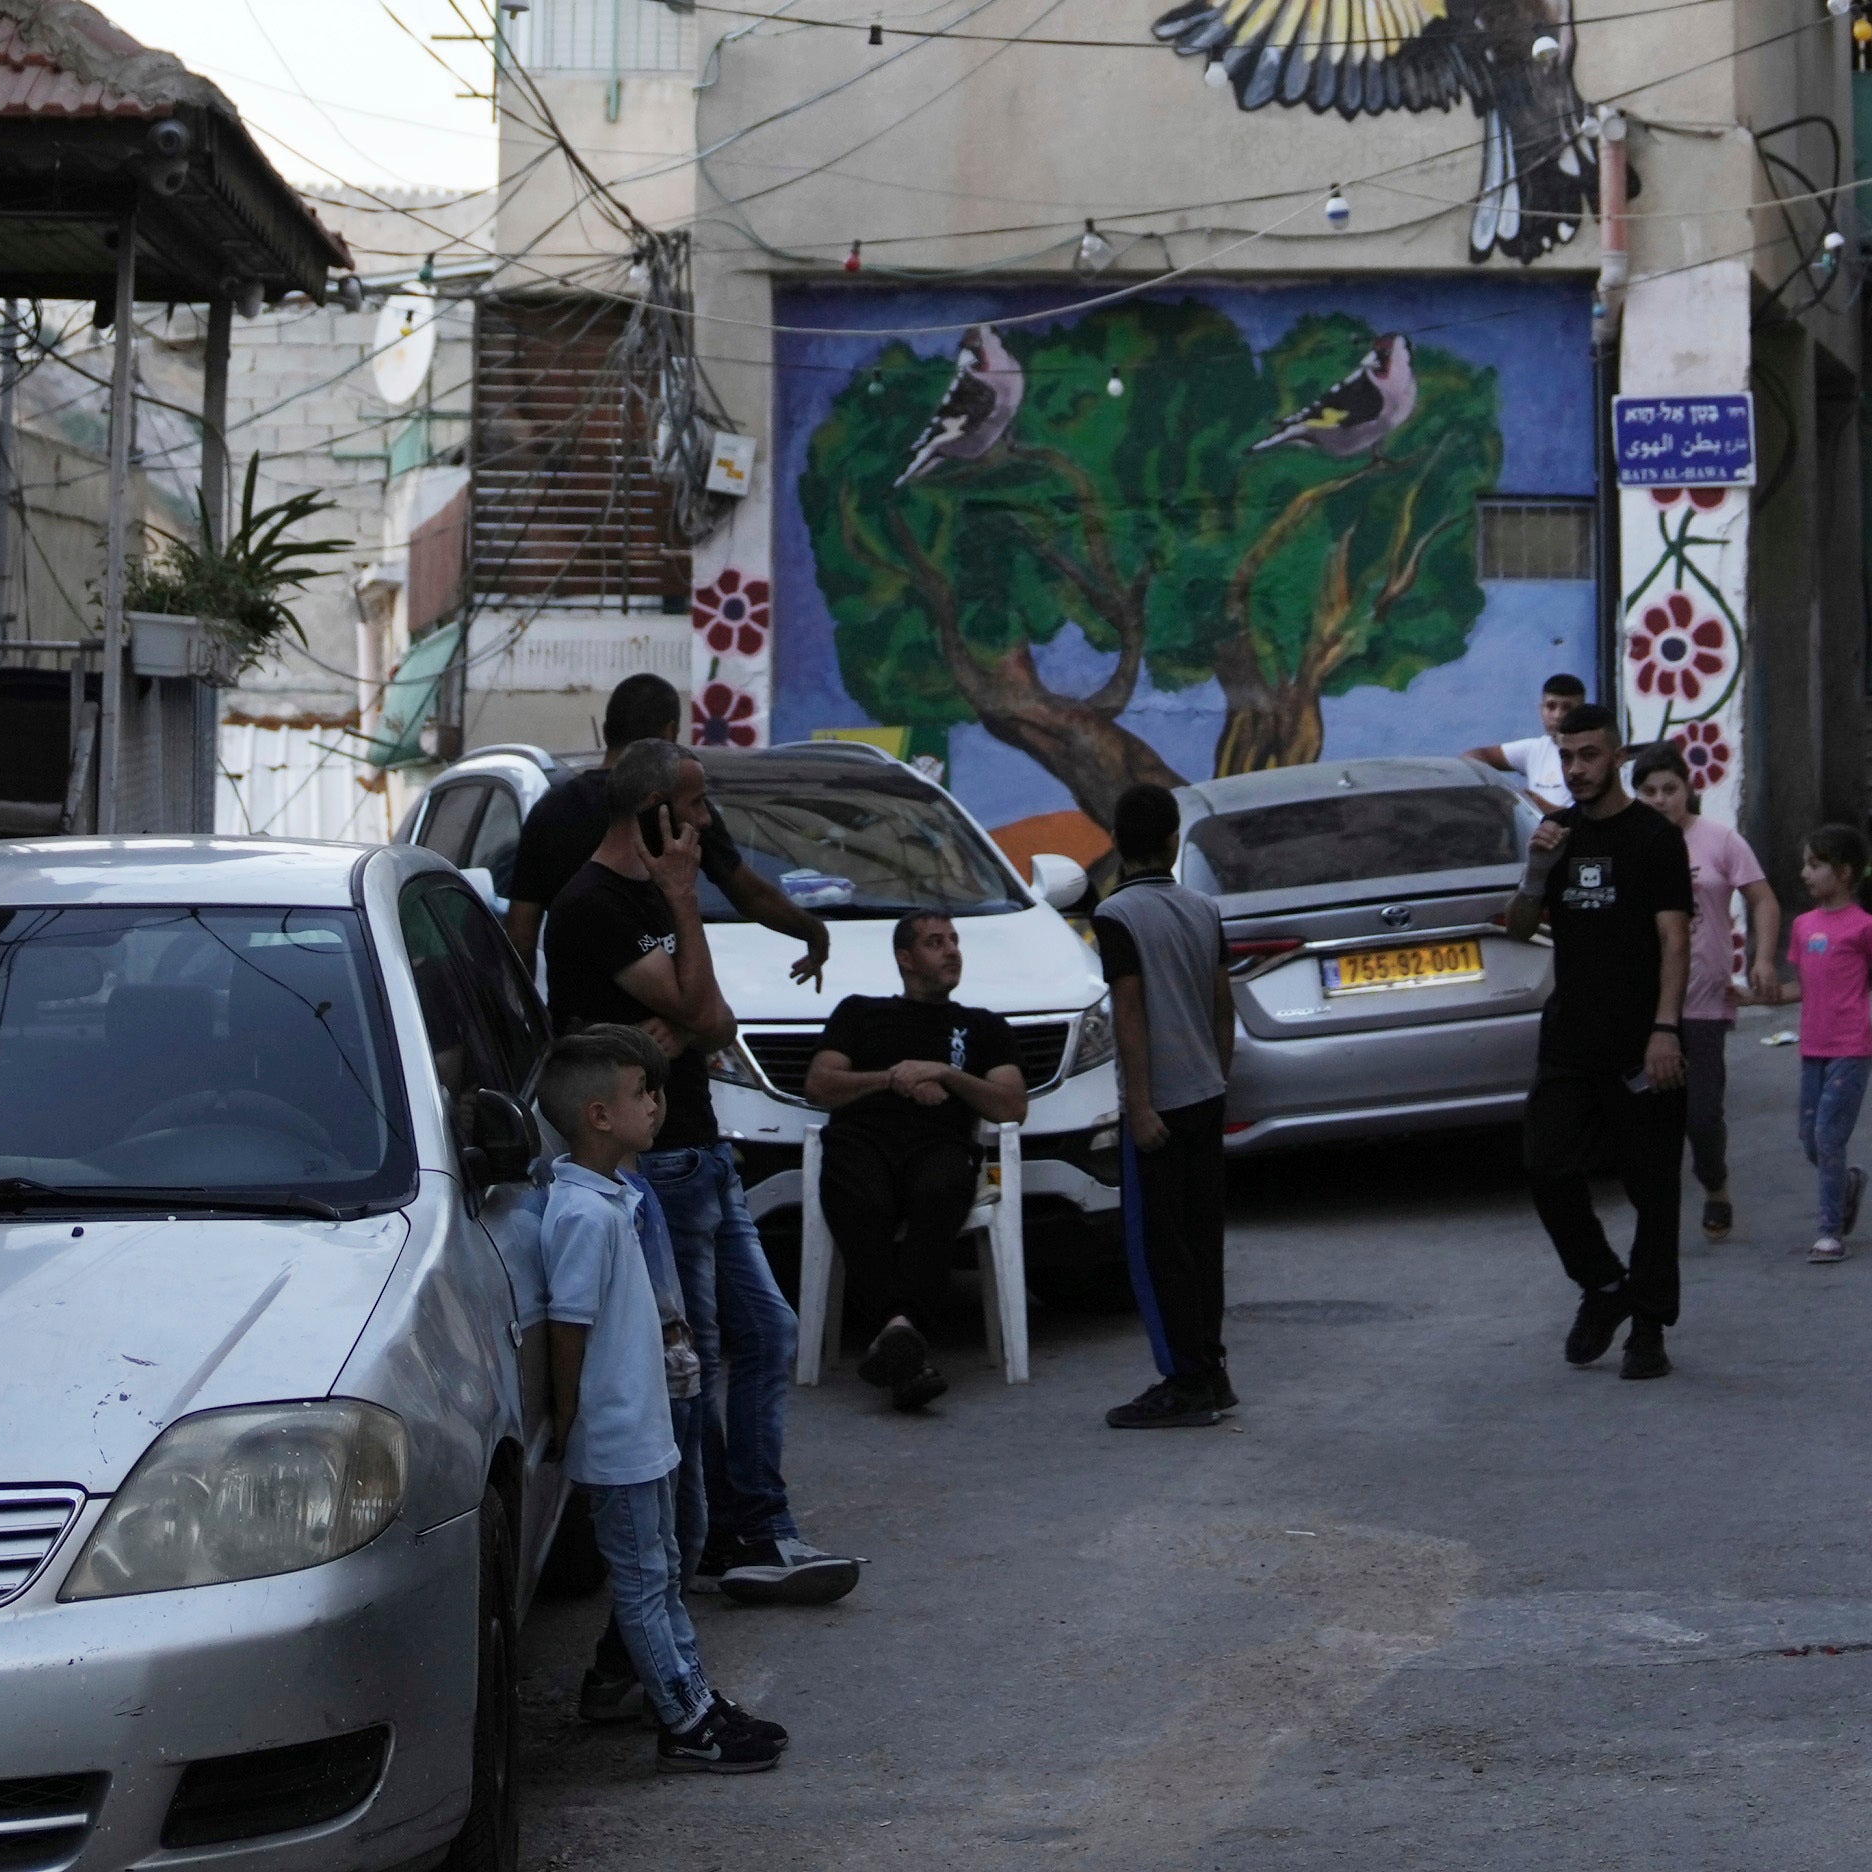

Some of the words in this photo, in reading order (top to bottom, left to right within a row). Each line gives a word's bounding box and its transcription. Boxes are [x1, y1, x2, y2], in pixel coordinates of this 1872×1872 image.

[1625, 432, 1674, 459] الهوى
[1680, 431, 1722, 458] بطن
[1663, 466, 1728, 480] AL-HAWA
